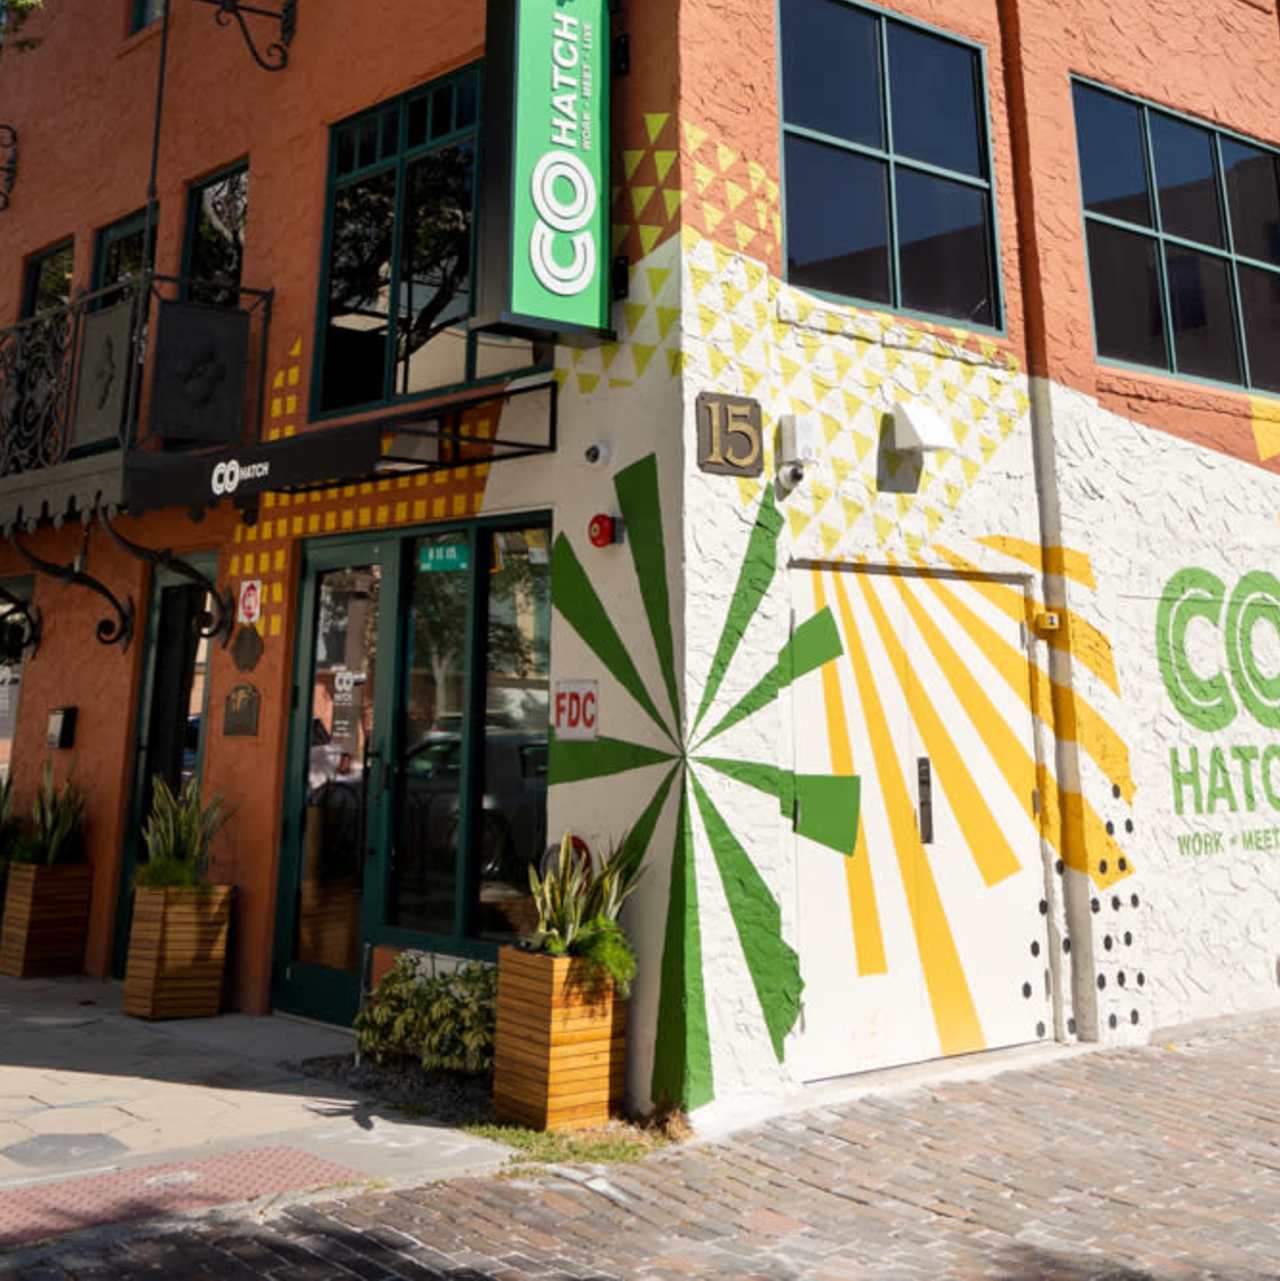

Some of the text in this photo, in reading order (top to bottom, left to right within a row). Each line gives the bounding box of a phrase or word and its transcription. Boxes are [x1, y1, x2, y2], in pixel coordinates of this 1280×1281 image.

[551, 11, 579, 148] HATCH
[705, 402, 760, 468] 15
[555, 690, 596, 729] FDC
[1178, 831, 1224, 856] WORK
